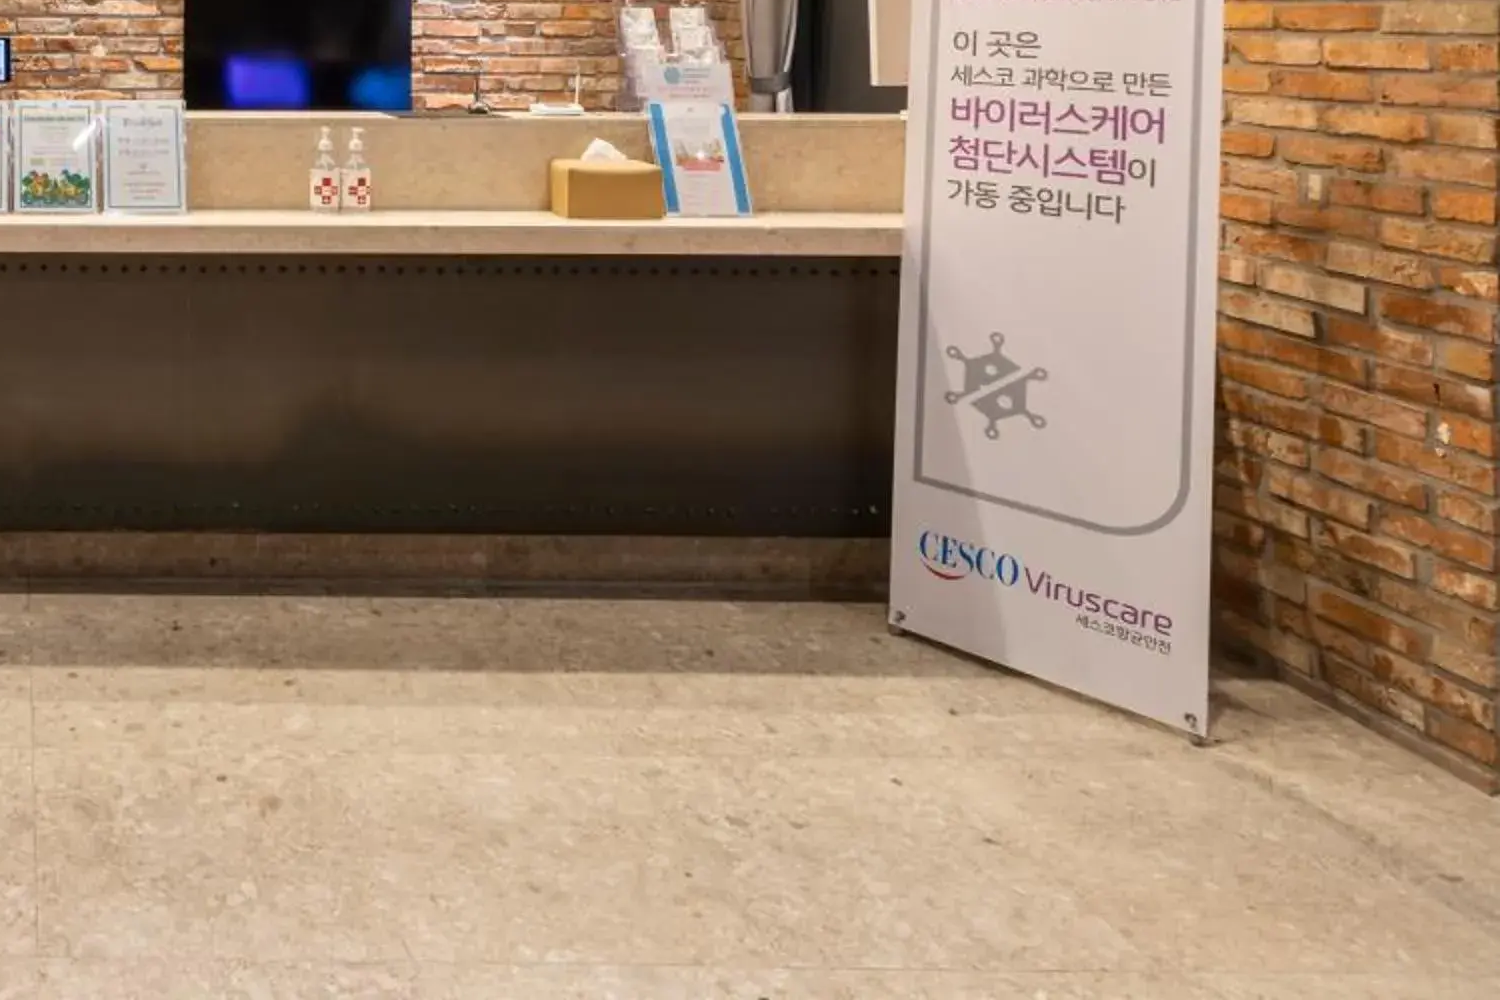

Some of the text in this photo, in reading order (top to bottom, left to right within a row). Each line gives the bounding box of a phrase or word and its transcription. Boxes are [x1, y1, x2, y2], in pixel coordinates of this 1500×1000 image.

[953, 30, 1042, 59] 이 곳은
[951, 64, 1173, 97] 세스코 과학으로 만든
[951, 95, 1165, 144] 바이러스케어
[948, 135, 1156, 188] 첨단시스템이
[947, 179, 1126, 224] 가동 중입니다
[919, 529, 1173, 636] CESCO Viruscare
